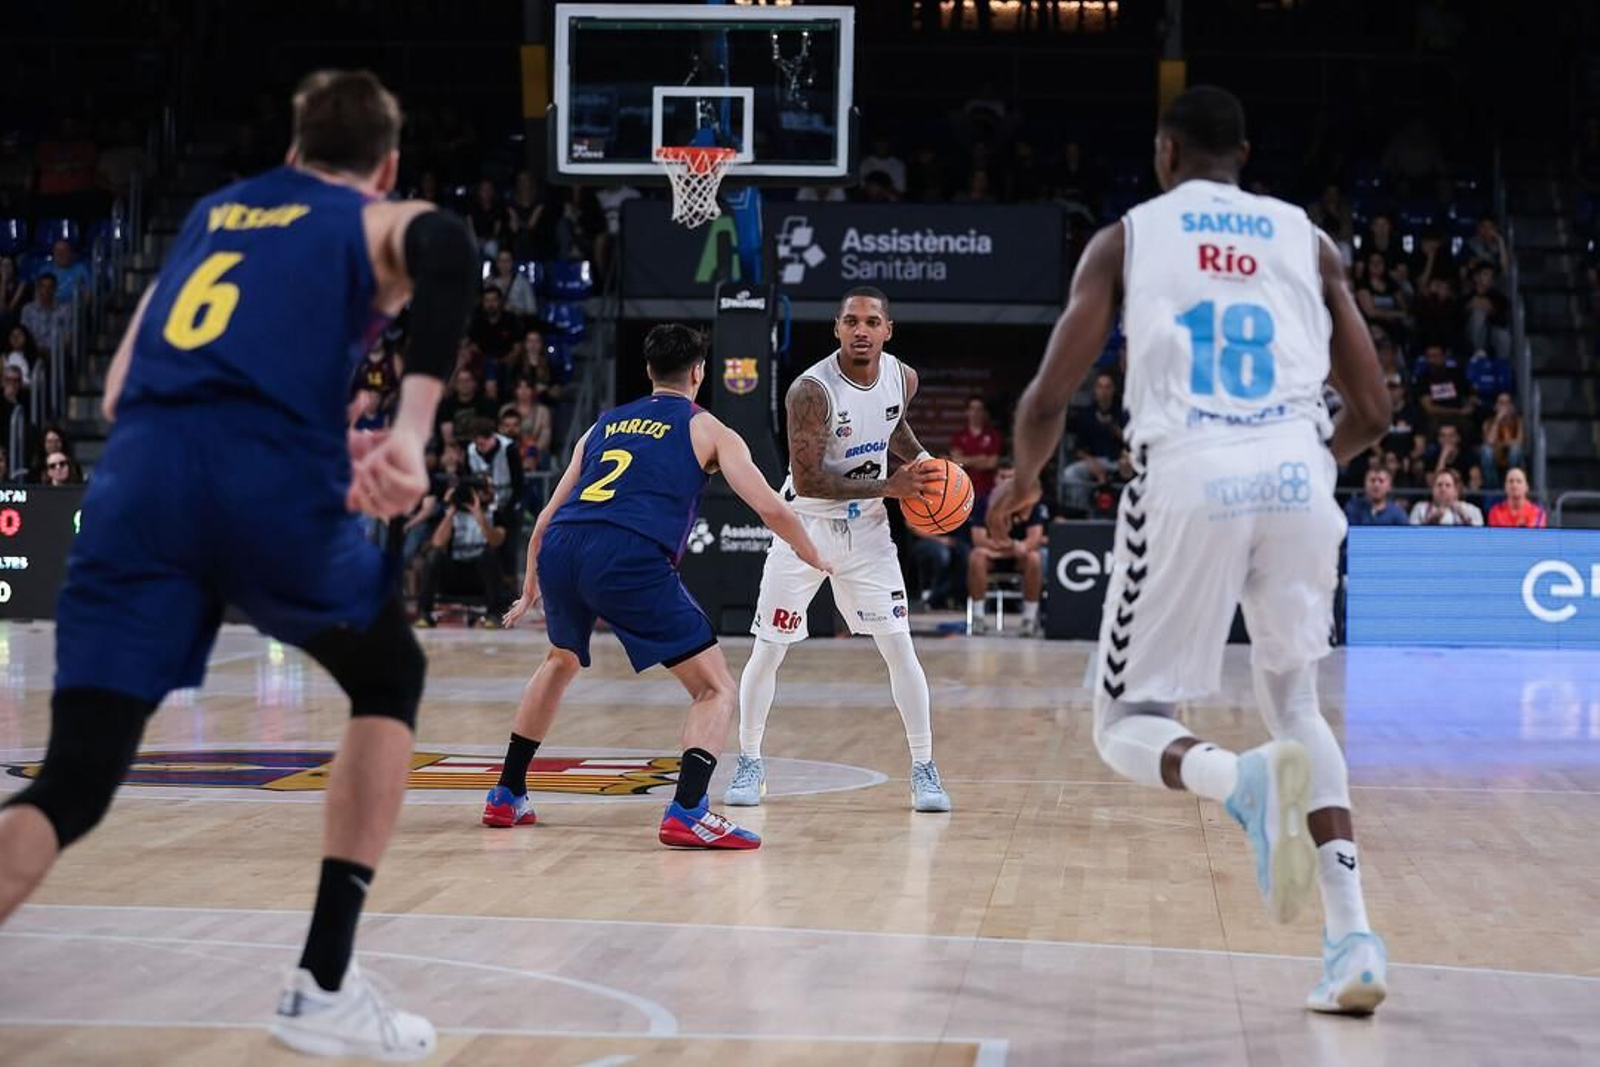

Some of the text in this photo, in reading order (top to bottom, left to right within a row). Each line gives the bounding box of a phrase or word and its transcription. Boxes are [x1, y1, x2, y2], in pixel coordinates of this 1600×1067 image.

[1181, 211, 1275, 239] SAKHO
[841, 227, 993, 254] Assistència
[841, 253, 948, 281] Sanitària
[1198, 243, 1257, 276] Río
[163, 252, 244, 350] 6
[1174, 299, 1276, 401] 18
[604, 418, 672, 439] MARCOS
[580, 449, 633, 502] 2
